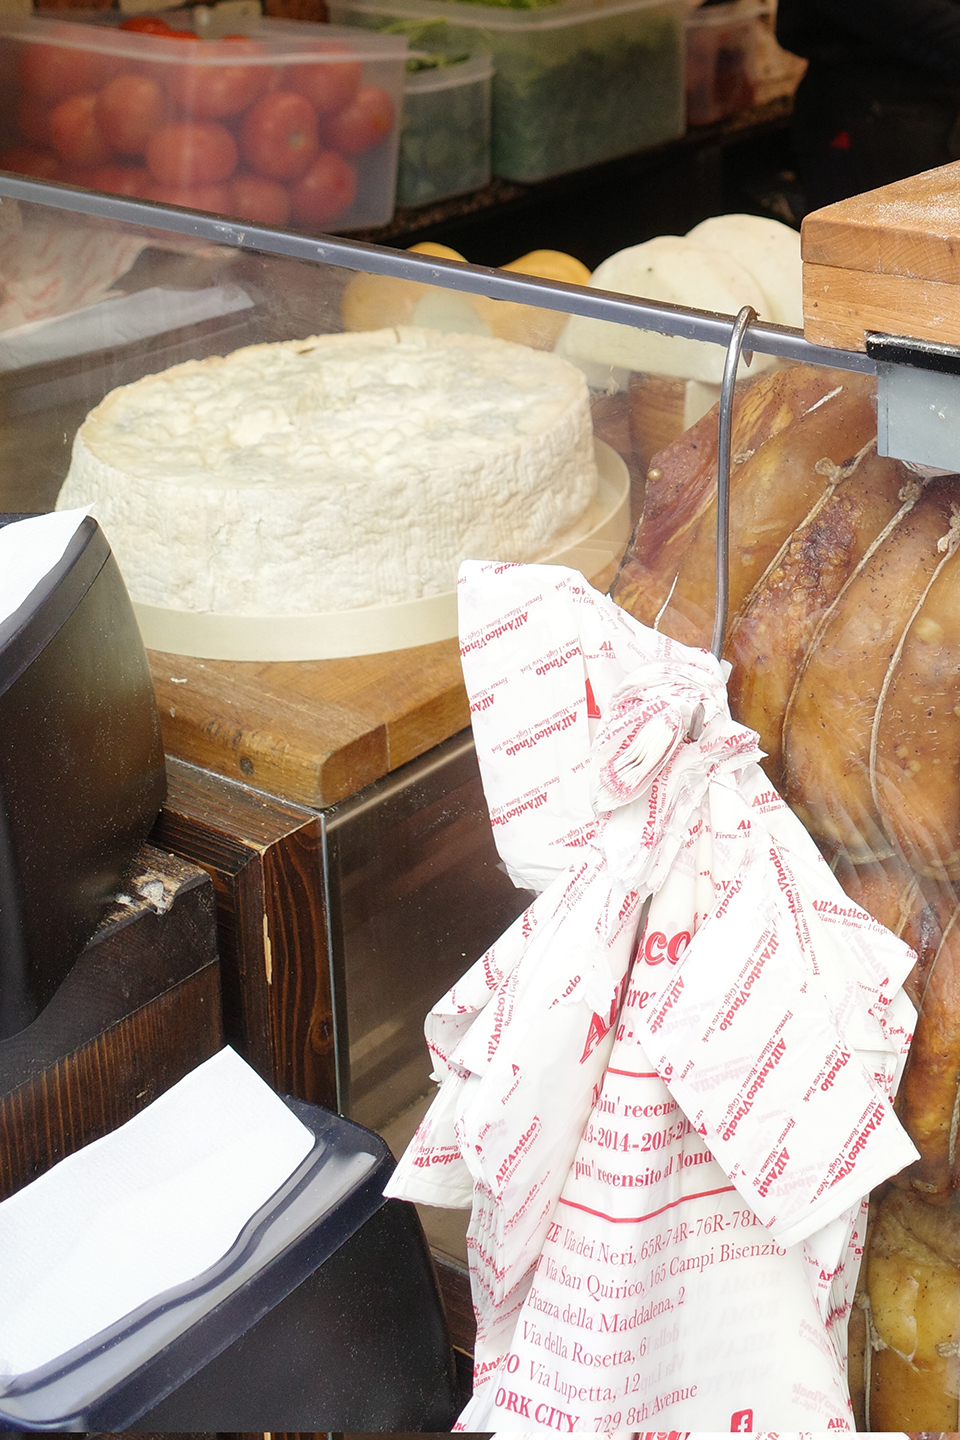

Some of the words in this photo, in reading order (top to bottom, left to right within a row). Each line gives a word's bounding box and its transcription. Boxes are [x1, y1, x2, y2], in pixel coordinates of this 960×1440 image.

[597, 1167, 662, 1187] recensito
[559, 1264, 581, 1290] San
[586, 1274, 645, 1302] Quirico,
[669, 1247, 714, 1277] Campi
[597, 1242, 637, 1266] Neri,
[527, 1287, 560, 1320] Piazza
[562, 1304, 594, 1330] della
[598, 1296, 674, 1334] Maddalena,
[677, 1286, 686, 1305] 2
[523, 1321, 542, 1346] Via
[544, 1332, 568, 1358] della
[571, 1342, 636, 1367] Rosetta,
[639, 1337, 647, 1357] 6
[529, 1361, 551, 1388] Via
[554, 1371, 617, 1404] Lupetta,
[623, 1373, 641, 1395] 12
[494, 1388, 533, 1418] ORK
[535, 1403, 581, 1433] CITY
[626, 1403, 649, 1426] 8th
[652, 1384, 698, 1416] Avenue
